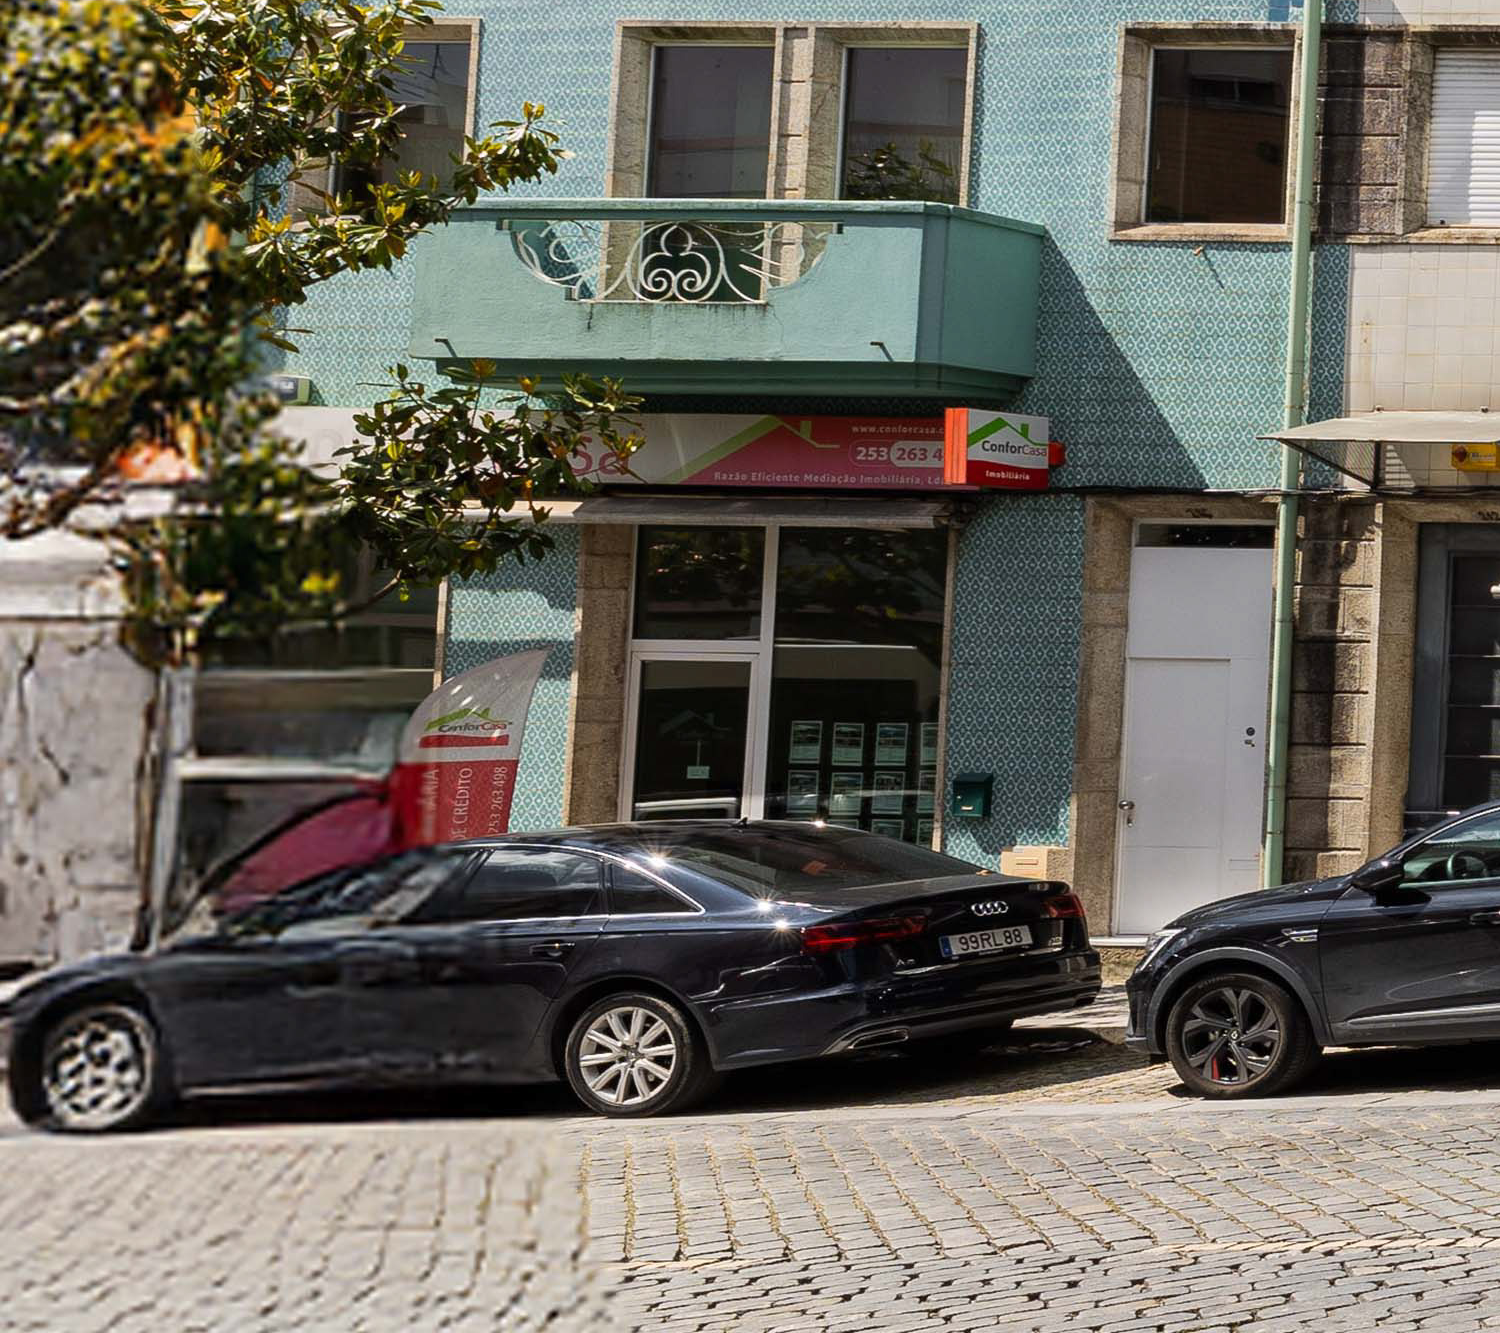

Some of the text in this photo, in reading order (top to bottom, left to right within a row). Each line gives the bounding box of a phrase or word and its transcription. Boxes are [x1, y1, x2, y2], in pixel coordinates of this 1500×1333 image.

[856, 446, 888, 461] 253
[896, 447, 928, 461] 263
[981, 440, 1047, 456] ConforCasa
[714, 471, 748, 481] Razão
[751, 471, 801, 482] Eficiente
[803, 472, 857, 484] Mediação
[985, 470, 1030, 481] Imobiliária
[493, 766, 508, 788] 498
[451, 767, 473, 824] CRÉDITO
[491, 789, 505, 811] 263
